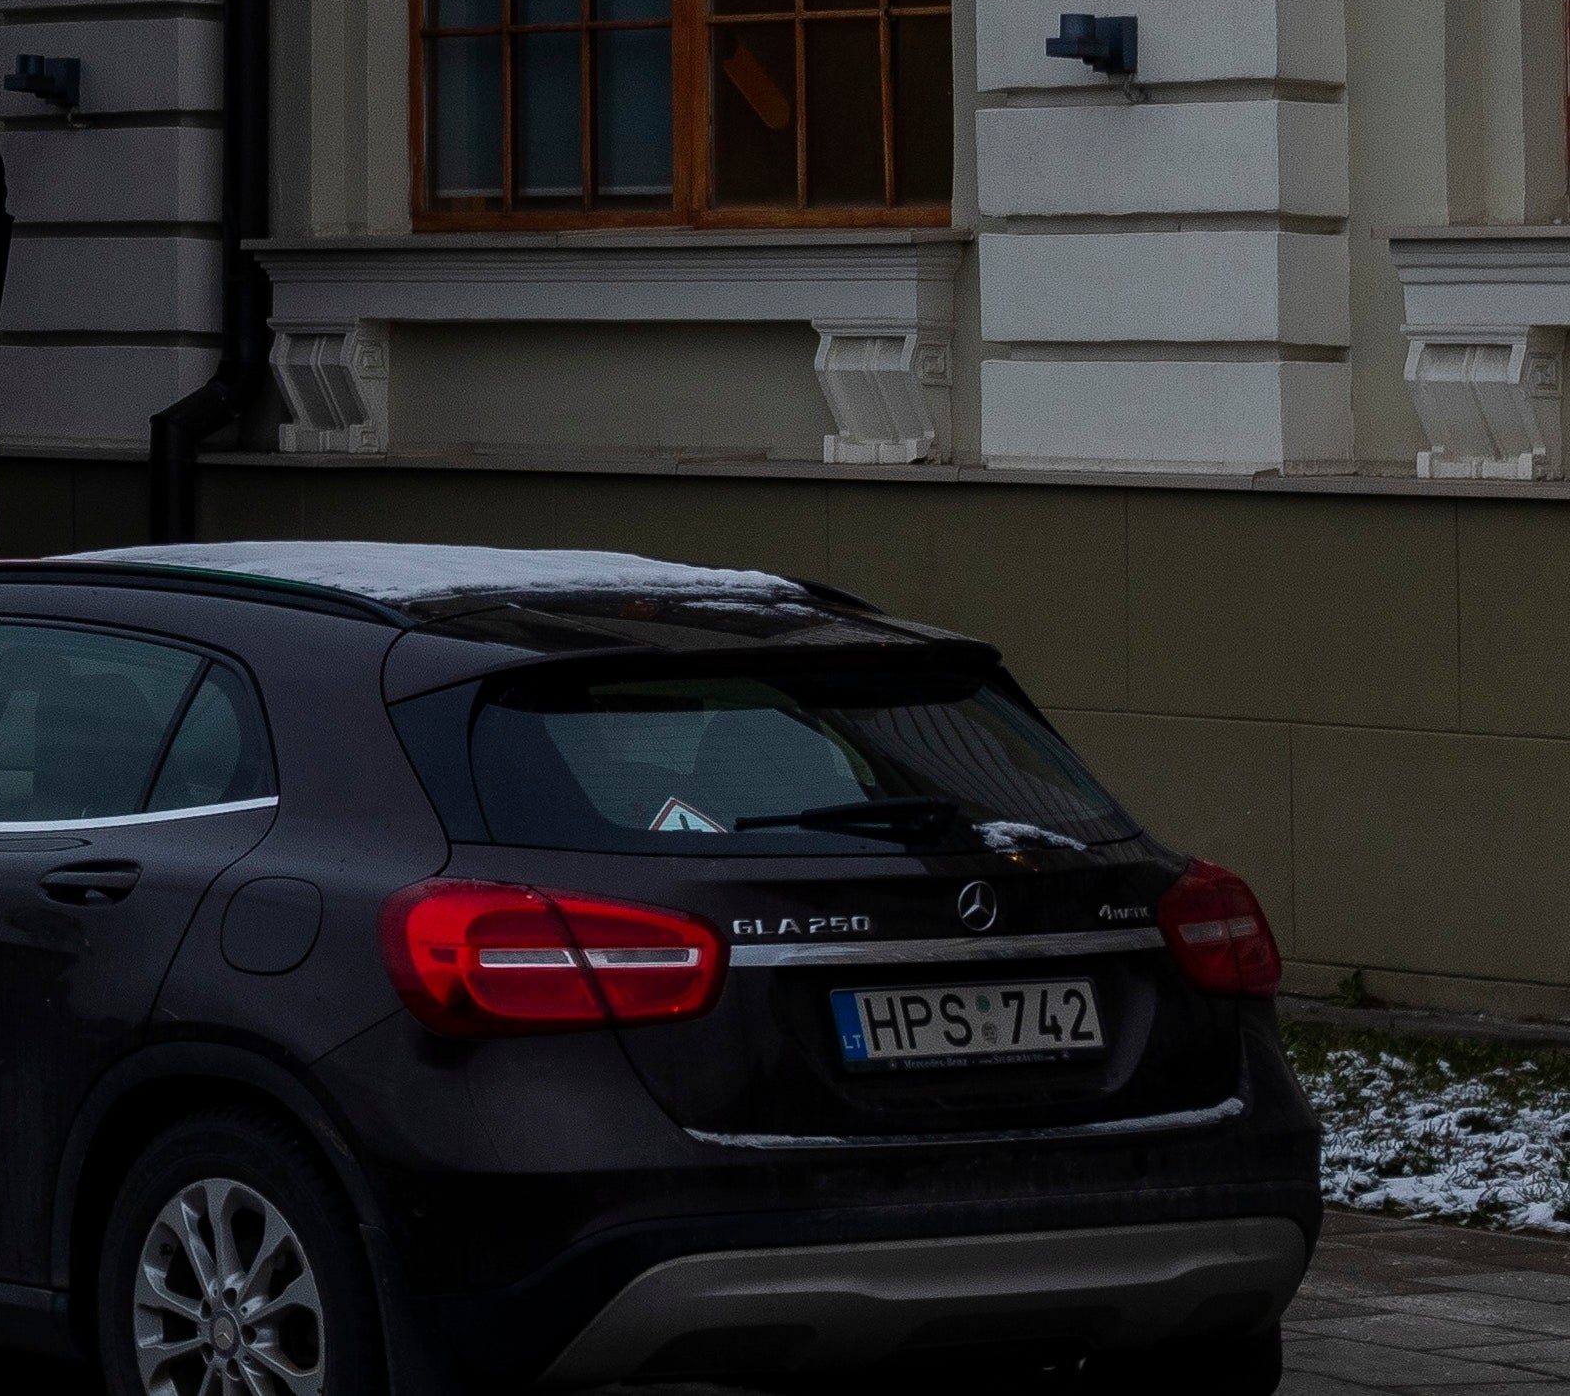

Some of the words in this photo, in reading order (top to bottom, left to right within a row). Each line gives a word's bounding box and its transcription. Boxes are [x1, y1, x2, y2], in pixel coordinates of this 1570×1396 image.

[732, 918, 802, 936] GLA
[808, 915, 871, 934] 250
[863, 994, 973, 1052] HPS
[1001, 989, 1094, 1045] 742
[842, 1033, 863, 1051] LT
